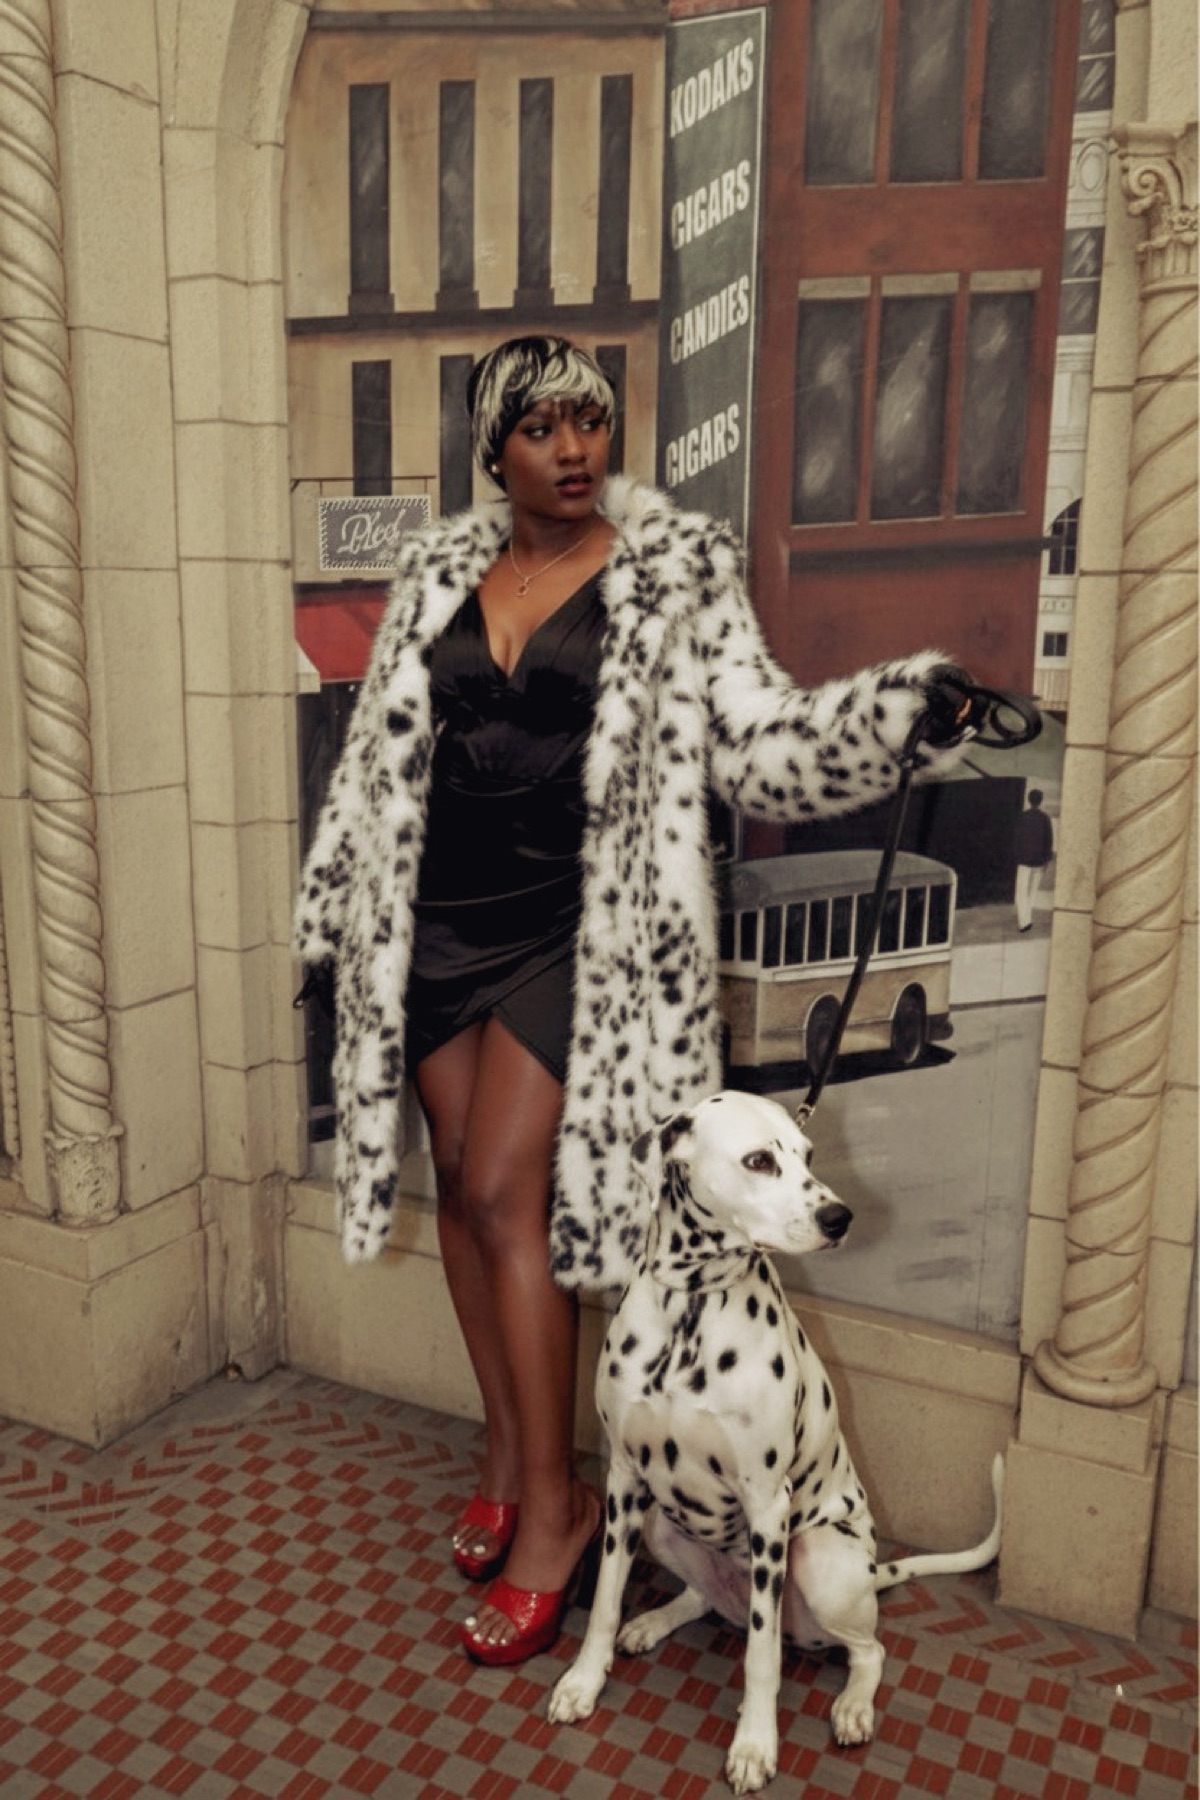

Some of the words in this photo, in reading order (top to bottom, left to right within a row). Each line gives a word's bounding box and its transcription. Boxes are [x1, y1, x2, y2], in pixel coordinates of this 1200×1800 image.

[671, 37, 754, 138] KODAKS
[671, 159, 751, 250] CIGARS
[671, 274, 750, 365] CANDIES
[665, 403, 740, 488] CIGARS
